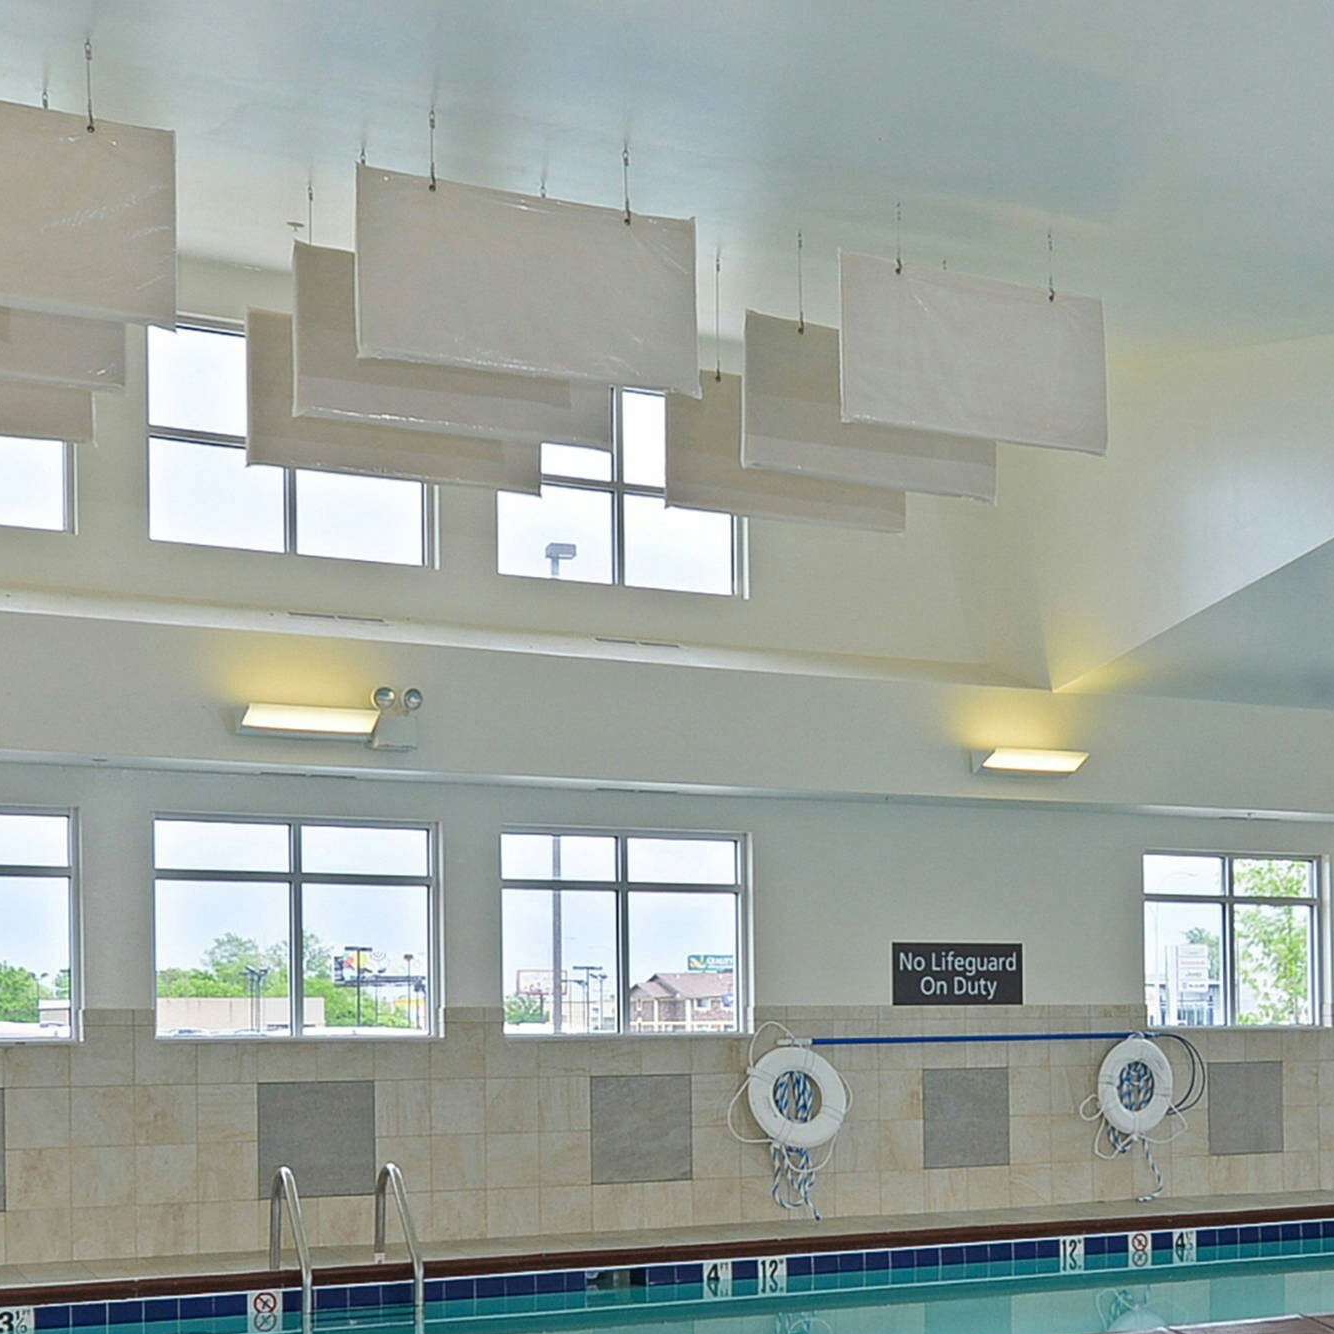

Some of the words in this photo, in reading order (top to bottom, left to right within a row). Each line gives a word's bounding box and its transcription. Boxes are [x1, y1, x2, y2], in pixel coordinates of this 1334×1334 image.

[899, 952, 925, 971] No
[931, 951, 1017, 976] Lifeguard
[920, 976, 948, 995] On
[953, 976, 998, 1000] Duty
[706, 1263, 720, 1281] 4
